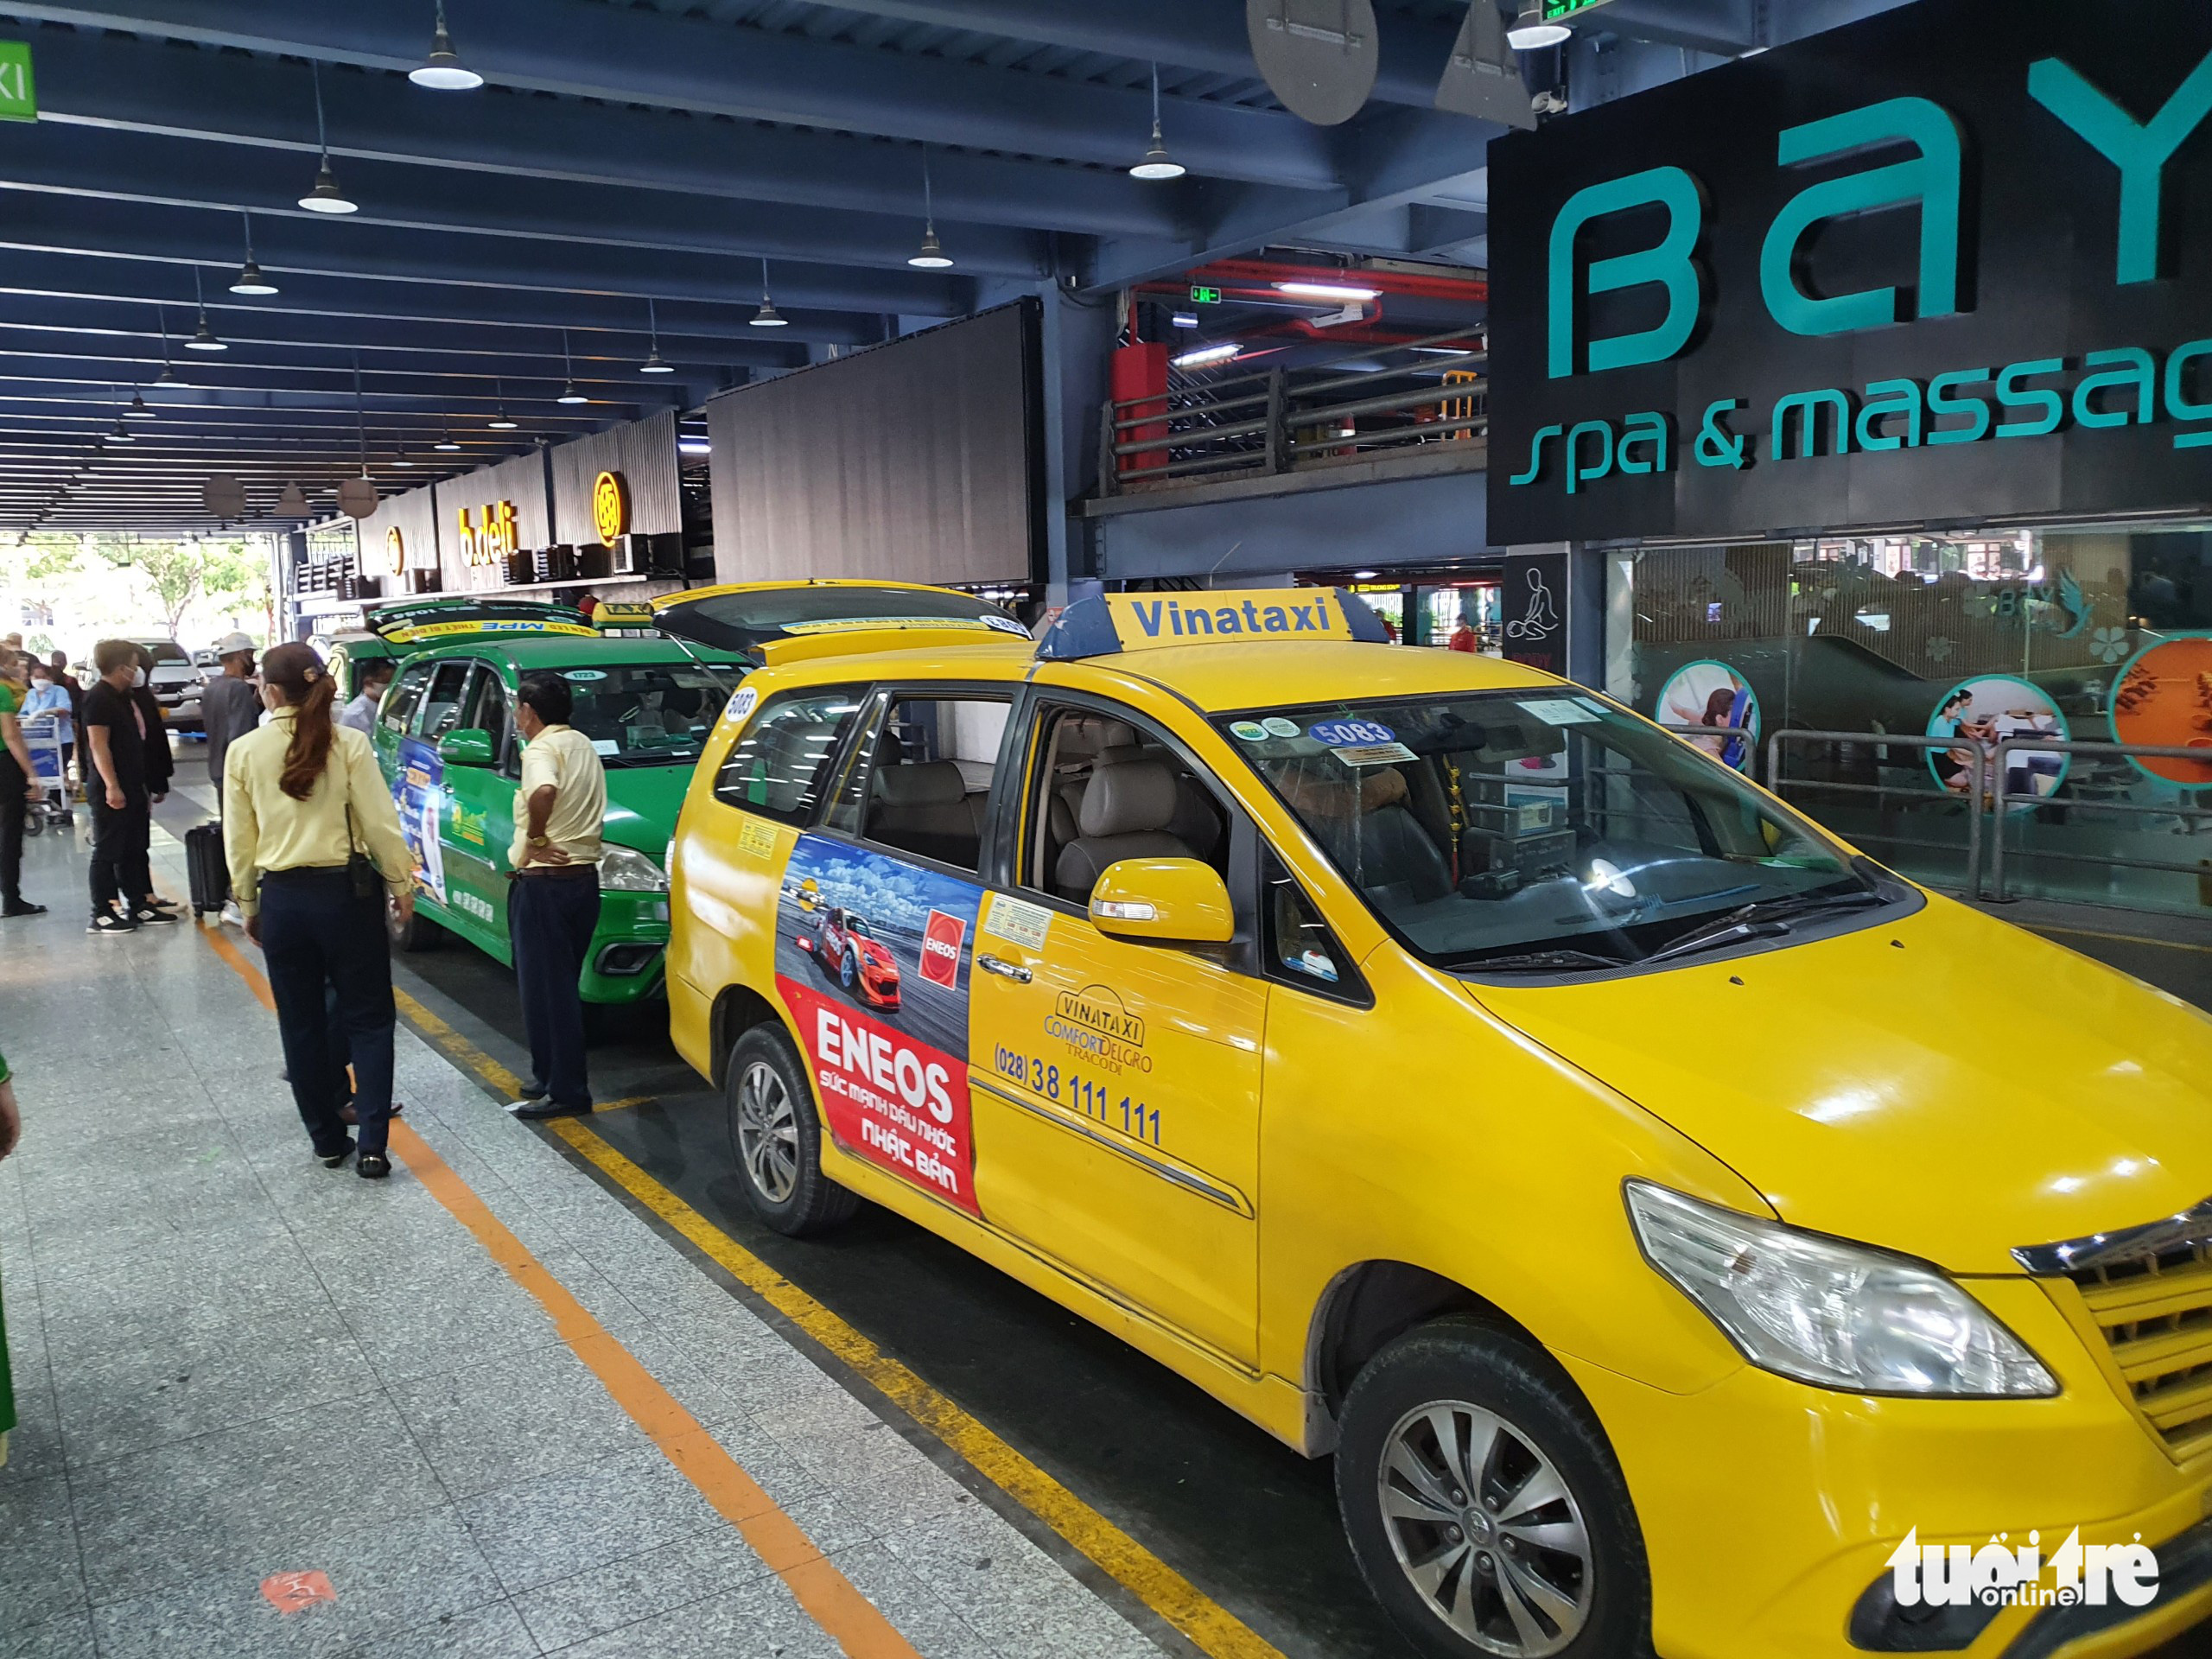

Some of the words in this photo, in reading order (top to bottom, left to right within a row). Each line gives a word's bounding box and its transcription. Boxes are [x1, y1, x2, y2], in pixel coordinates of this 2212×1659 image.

[1548, 5, 1566, 18] EXIT
[1510, 411, 1668, 495] spa
[1694, 398, 1745, 471] &
[458, 499, 512, 568] b.deli
[1130, 596, 1331, 637] Vinataxi
[728, 693, 754, 715] 5083
[1315, 722, 1392, 744] 5083
[925, 938, 957, 960] ENEOS
[1065, 997, 1139, 1039] VINATAXI
[817, 1007, 953, 1123] ENEOS
[1065, 1042, 1122, 1076] TRACODI
[995, 1042, 1028, 1085] (028)
[1032, 1058, 1059, 1099] 38
[1070, 1075, 1106, 1121] 111
[1120, 1096, 1160, 1146] 111
[861, 1117, 914, 1167] NHẬT
[915, 1151, 958, 1194] BẢN
